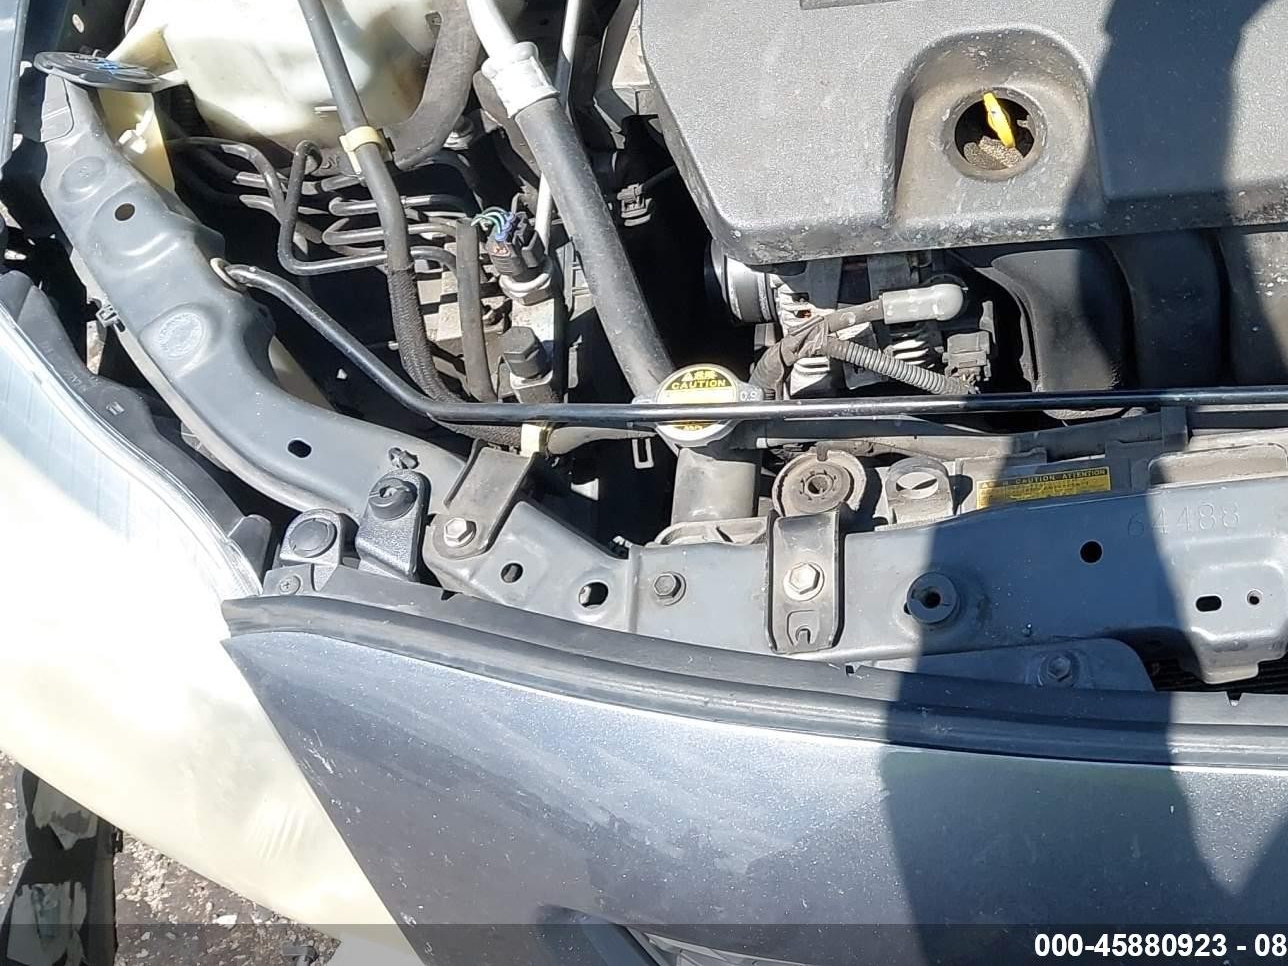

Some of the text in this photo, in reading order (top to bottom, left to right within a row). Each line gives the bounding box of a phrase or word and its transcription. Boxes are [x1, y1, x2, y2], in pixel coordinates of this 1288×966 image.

[671, 379, 726, 390] CAUTION
[1016, 468, 1106, 484] CAUTION ATTENTION
